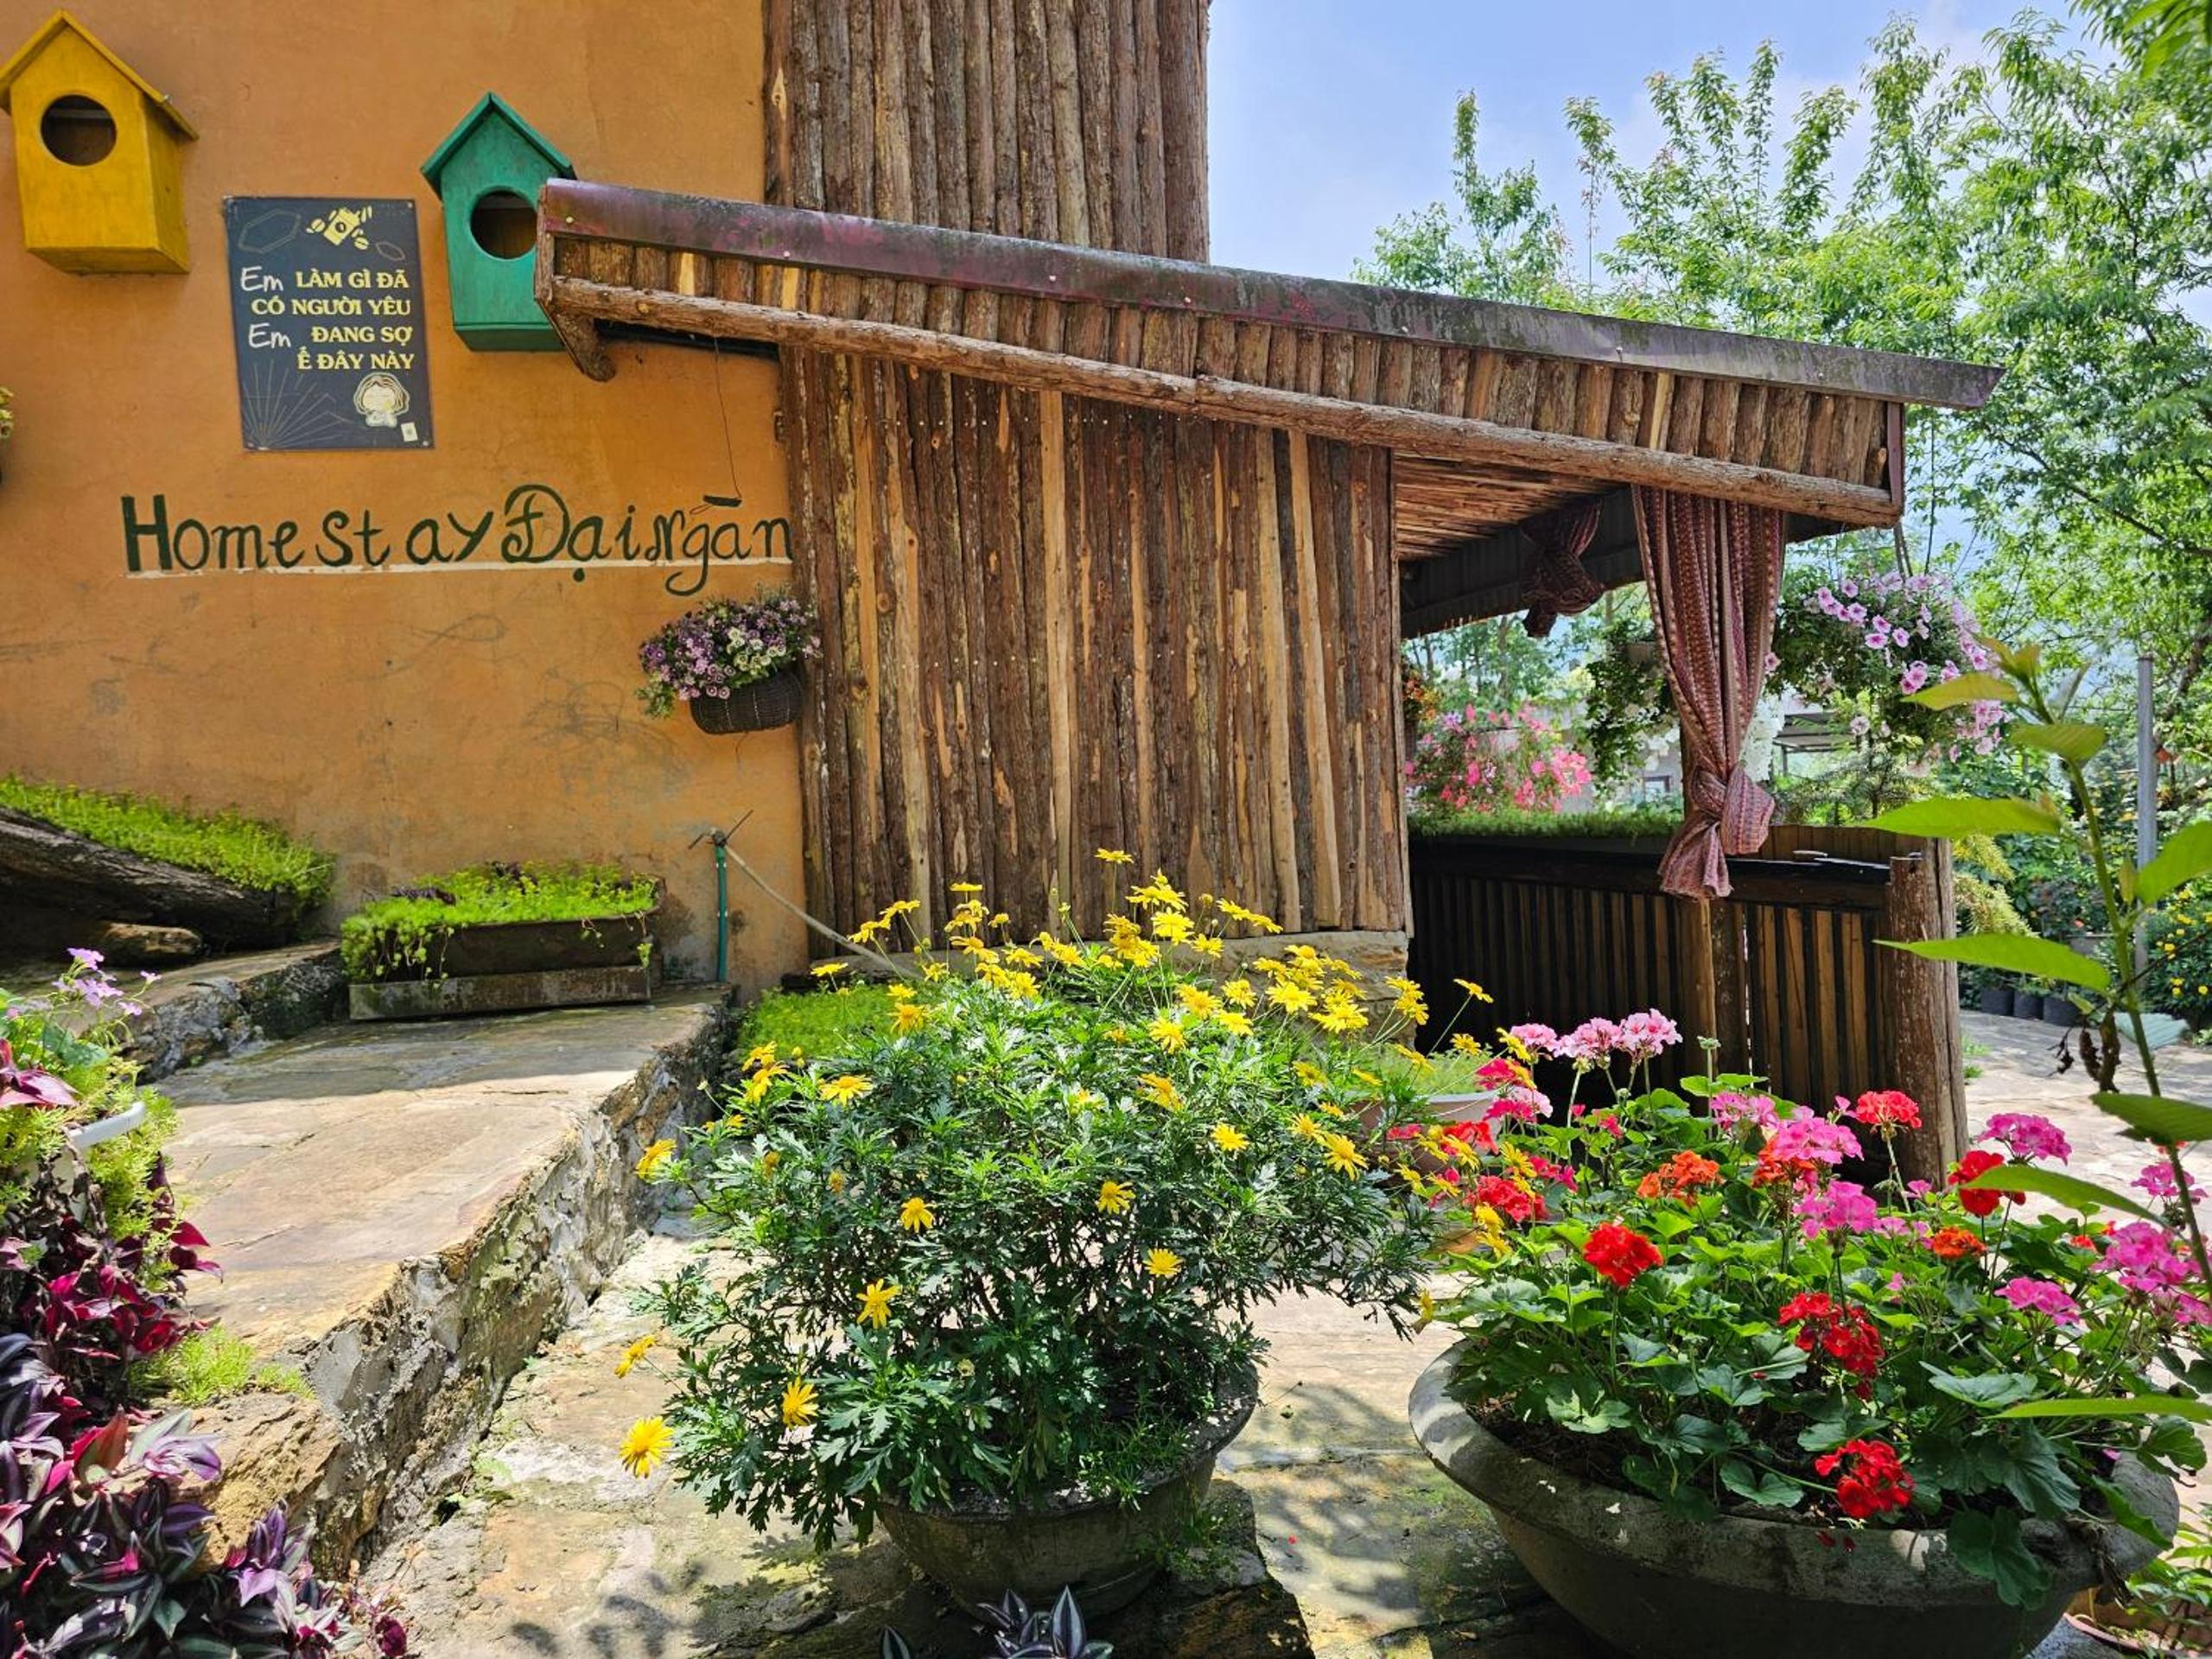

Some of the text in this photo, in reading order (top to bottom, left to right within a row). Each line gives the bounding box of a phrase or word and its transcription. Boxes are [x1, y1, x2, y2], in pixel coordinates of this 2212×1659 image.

[240, 265, 410, 292] Em LÀM GÌ ĐÃ
[251, 295, 411, 315] CÓ NGƯỜI YÊU
[248, 322, 414, 349] Em ĐANG SỢ
[316, 350, 364, 371] ĐÂY
[371, 350, 415, 371] NÀY
